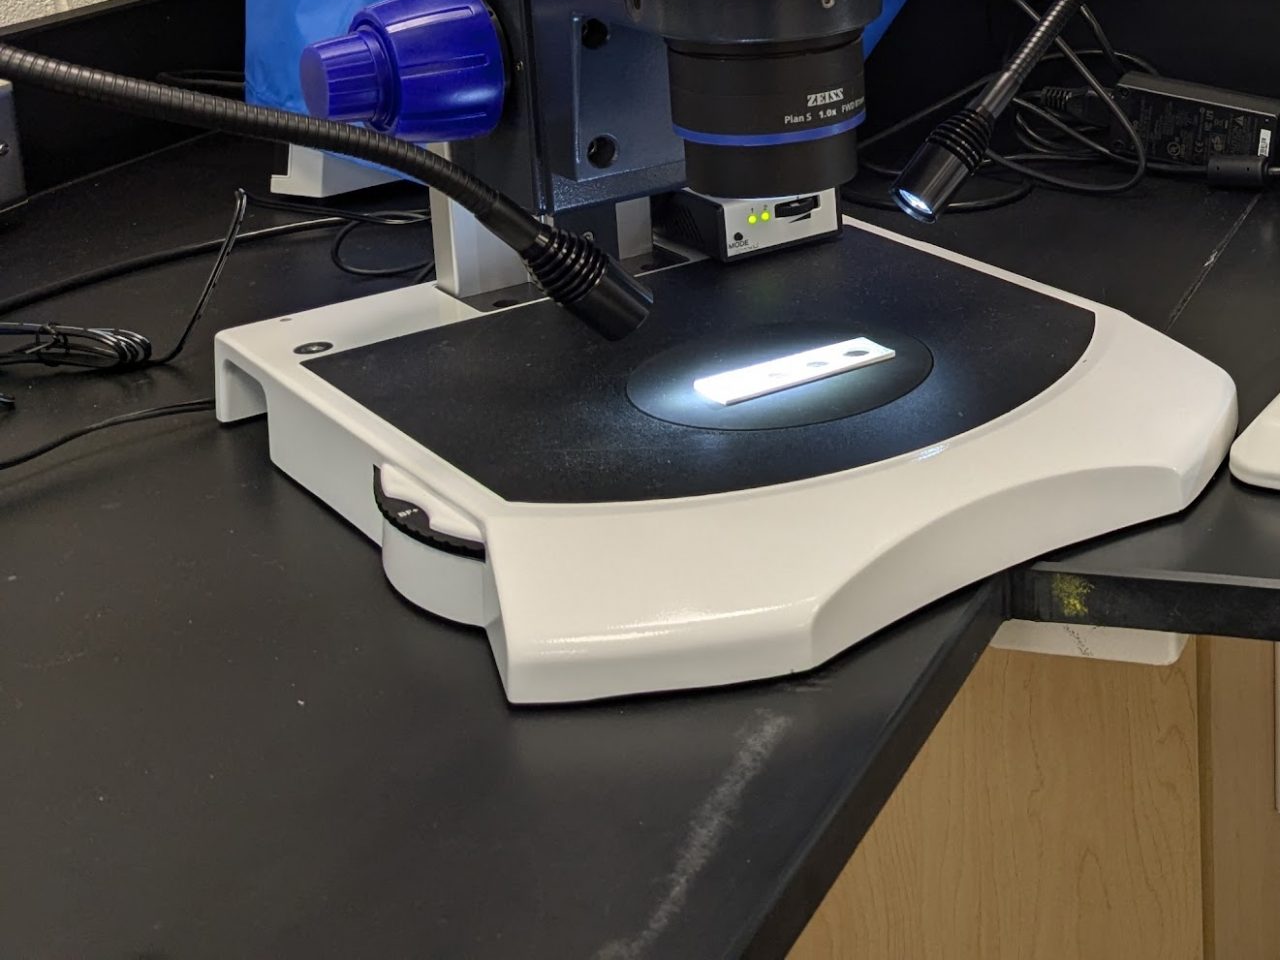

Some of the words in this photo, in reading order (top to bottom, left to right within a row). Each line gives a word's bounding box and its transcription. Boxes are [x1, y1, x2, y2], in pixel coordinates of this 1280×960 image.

[807, 88, 844, 107] ZEISS
[784, 114, 805, 124] Plan
[819, 108, 837, 119] 1.0x
[728, 240, 749, 249] MODE
